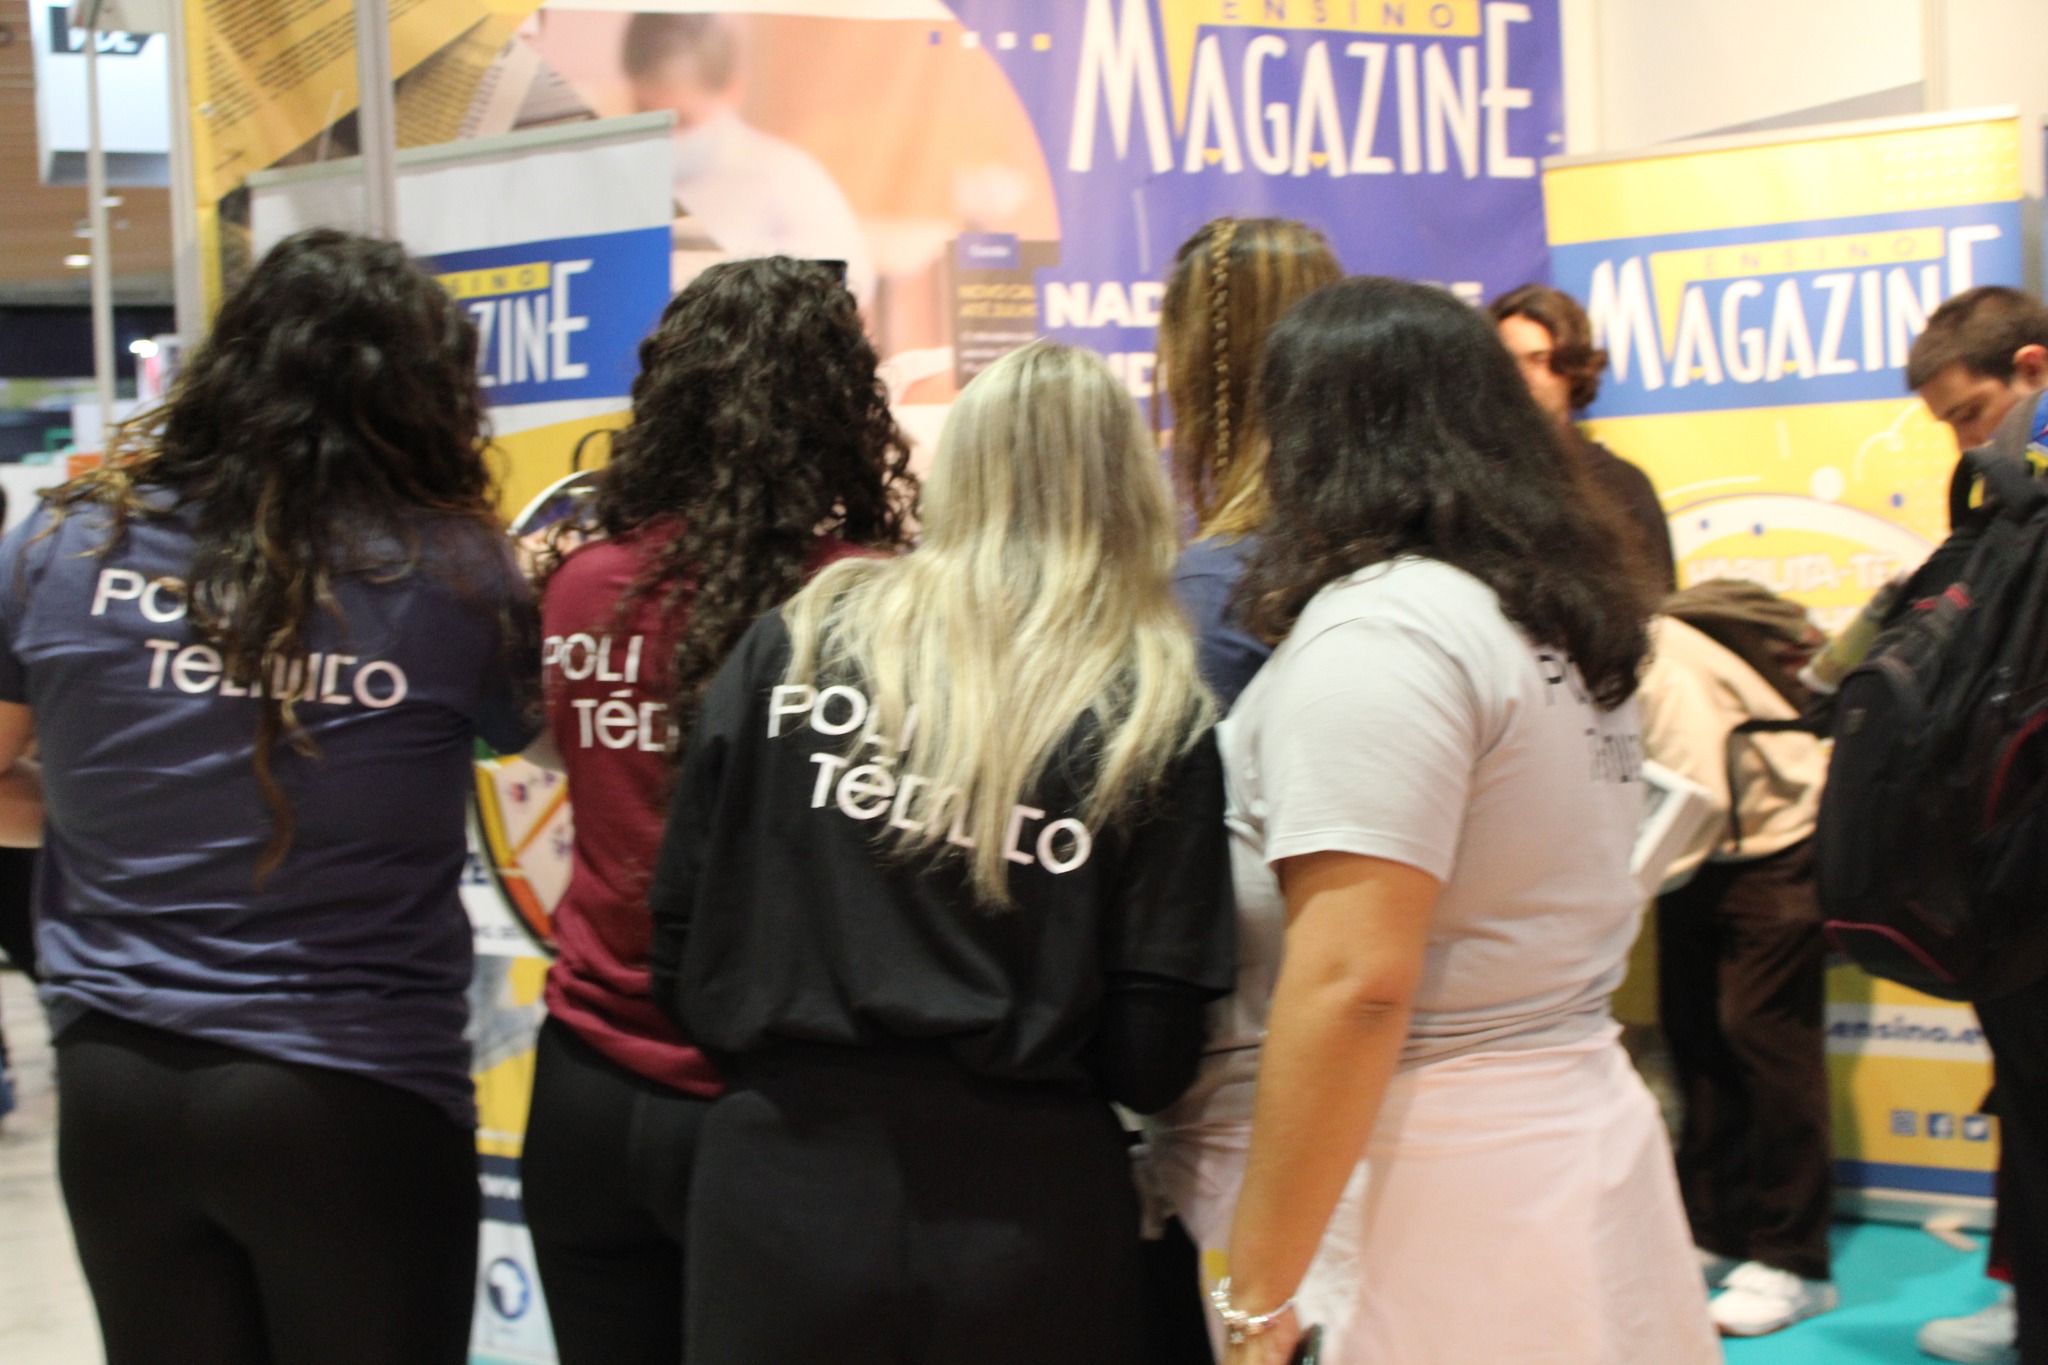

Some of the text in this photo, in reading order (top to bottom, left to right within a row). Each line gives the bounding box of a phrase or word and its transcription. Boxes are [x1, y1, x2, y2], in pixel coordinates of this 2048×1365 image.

[1221, 1, 1455, 29] ENSINO
[1068, 0, 1536, 178] MAGAZINE
[468, 259, 595, 389] ZINE
[542, 632, 644, 683] POLI
